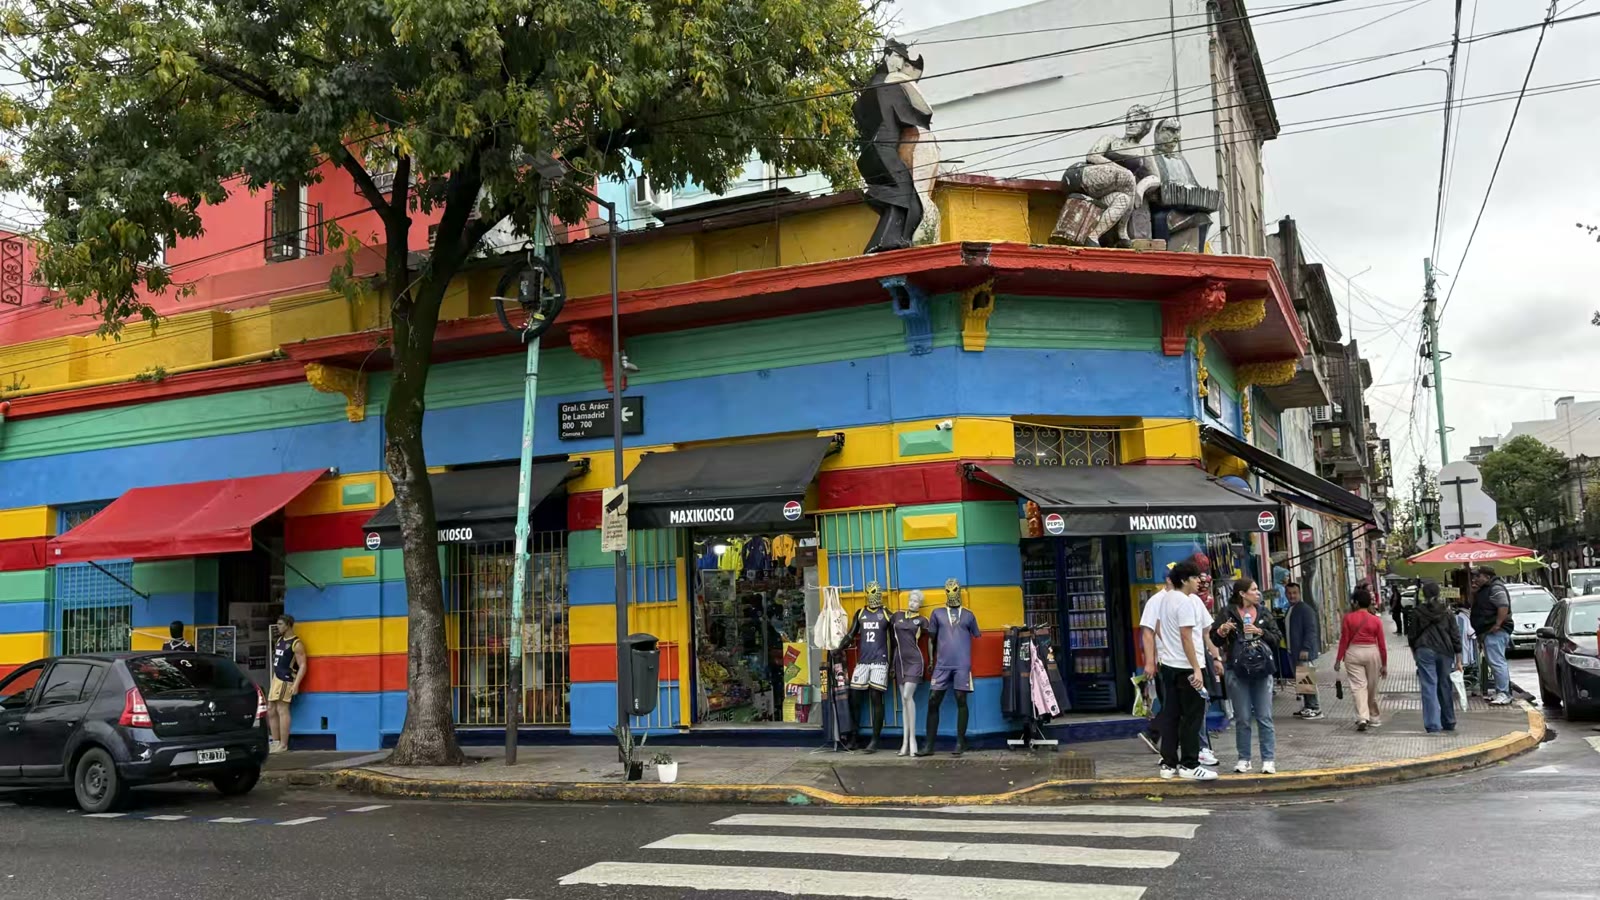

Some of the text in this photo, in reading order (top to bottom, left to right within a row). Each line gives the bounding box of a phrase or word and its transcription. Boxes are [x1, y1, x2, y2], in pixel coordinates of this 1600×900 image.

[562, 404, 579, 412] Gral.
[589, 402, 609, 410] Aráoz
[562, 411, 605, 421] De Lamadrid
[562, 420, 593, 430] 800 700
[670, 507, 734, 524] MAXIKIOSCO
[1129, 514, 1197, 531] MAXIKIOSCO
[437, 527, 473, 542] IKIOSCO
[1444, 549, 1497, 561] Coca-Cola
[863, 622, 879, 630] BOCA
[866, 631, 876, 643] 12
